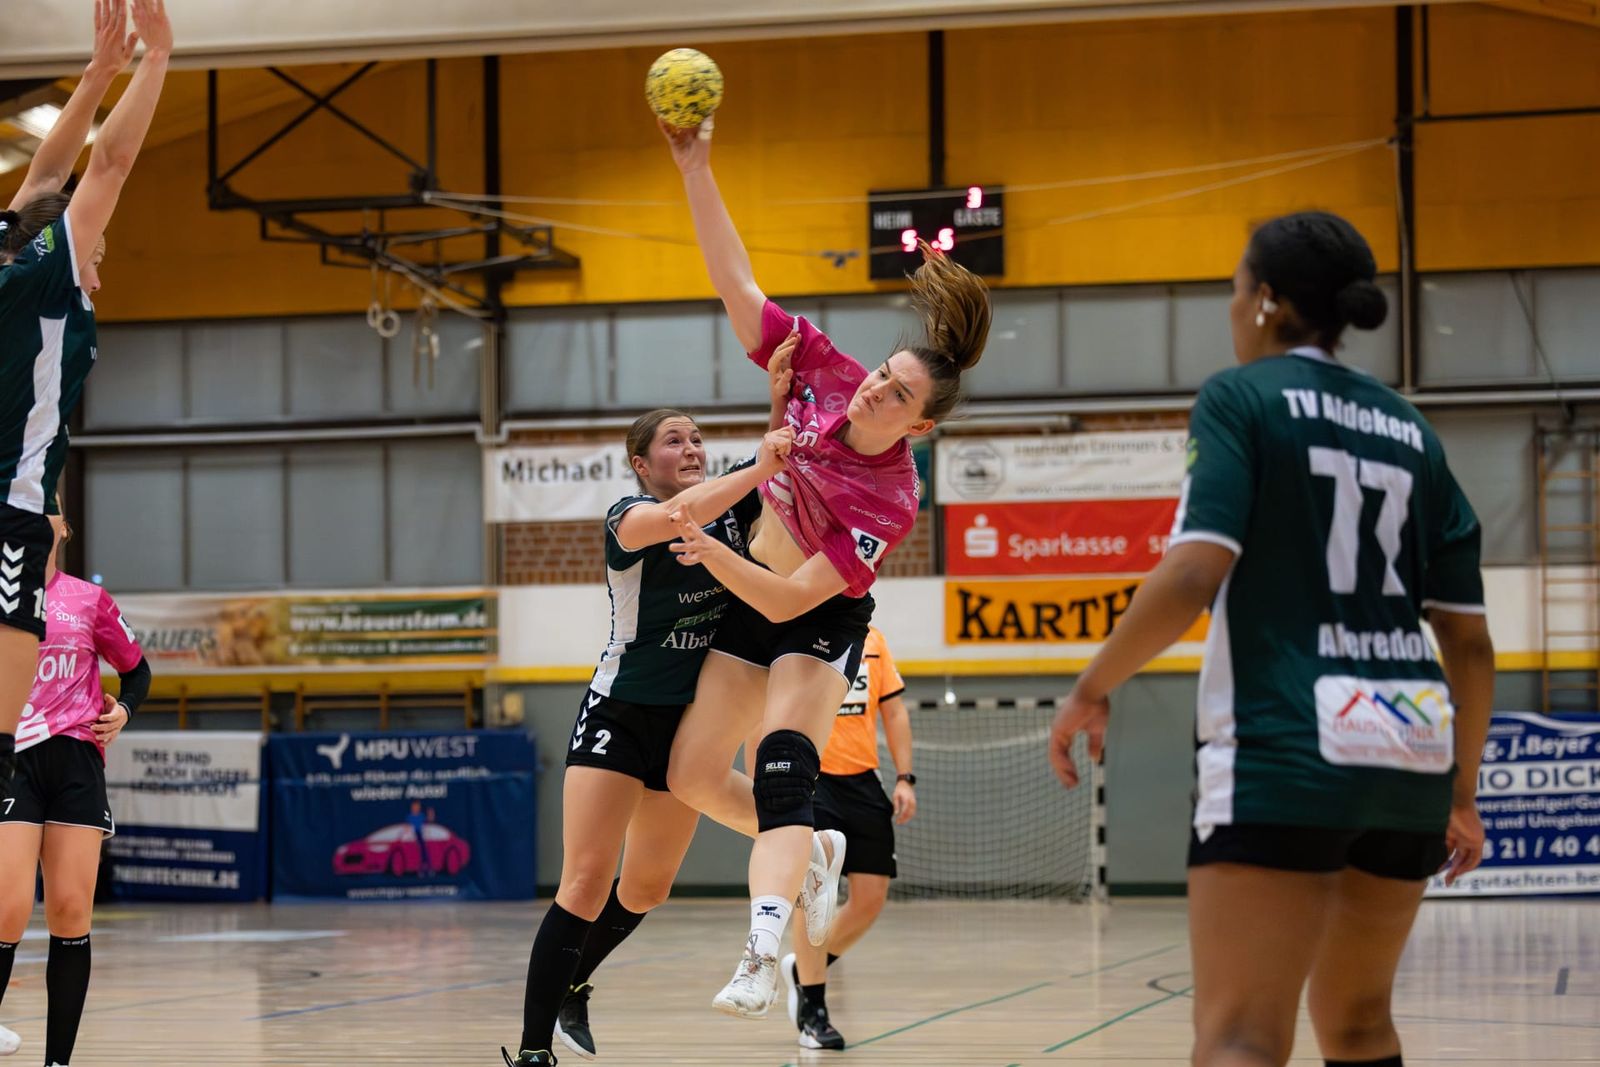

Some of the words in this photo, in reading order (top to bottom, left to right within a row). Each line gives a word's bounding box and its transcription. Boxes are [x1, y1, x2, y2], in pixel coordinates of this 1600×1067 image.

[966, 186, 982, 209] 3
[873, 210, 913, 230] HEIM
[901, 229, 918, 252] 5
[1281, 388, 1318, 419] TV
[1321, 392, 1424, 453] Aldekerk
[501, 454, 613, 483] Michael
[1307, 445, 1414, 597] 77
[1007, 532, 1128, 562] Sparkasse
[55, 612, 77, 625] SDK
[812, 643, 830, 654] erima
[591, 729, 612, 755] 2
[132, 749, 169, 763] TORE
[175, 751, 212, 766] SIND
[765, 762, 791, 770] SELECT
[351, 785, 405, 801] wieder
[405, 784, 448, 800] Auto!
[2, 797, 15, 815] 7
[1500, 836, 1527, 859] 21
[1550, 835, 1580, 858] 40
[756, 911, 781, 920] erima
